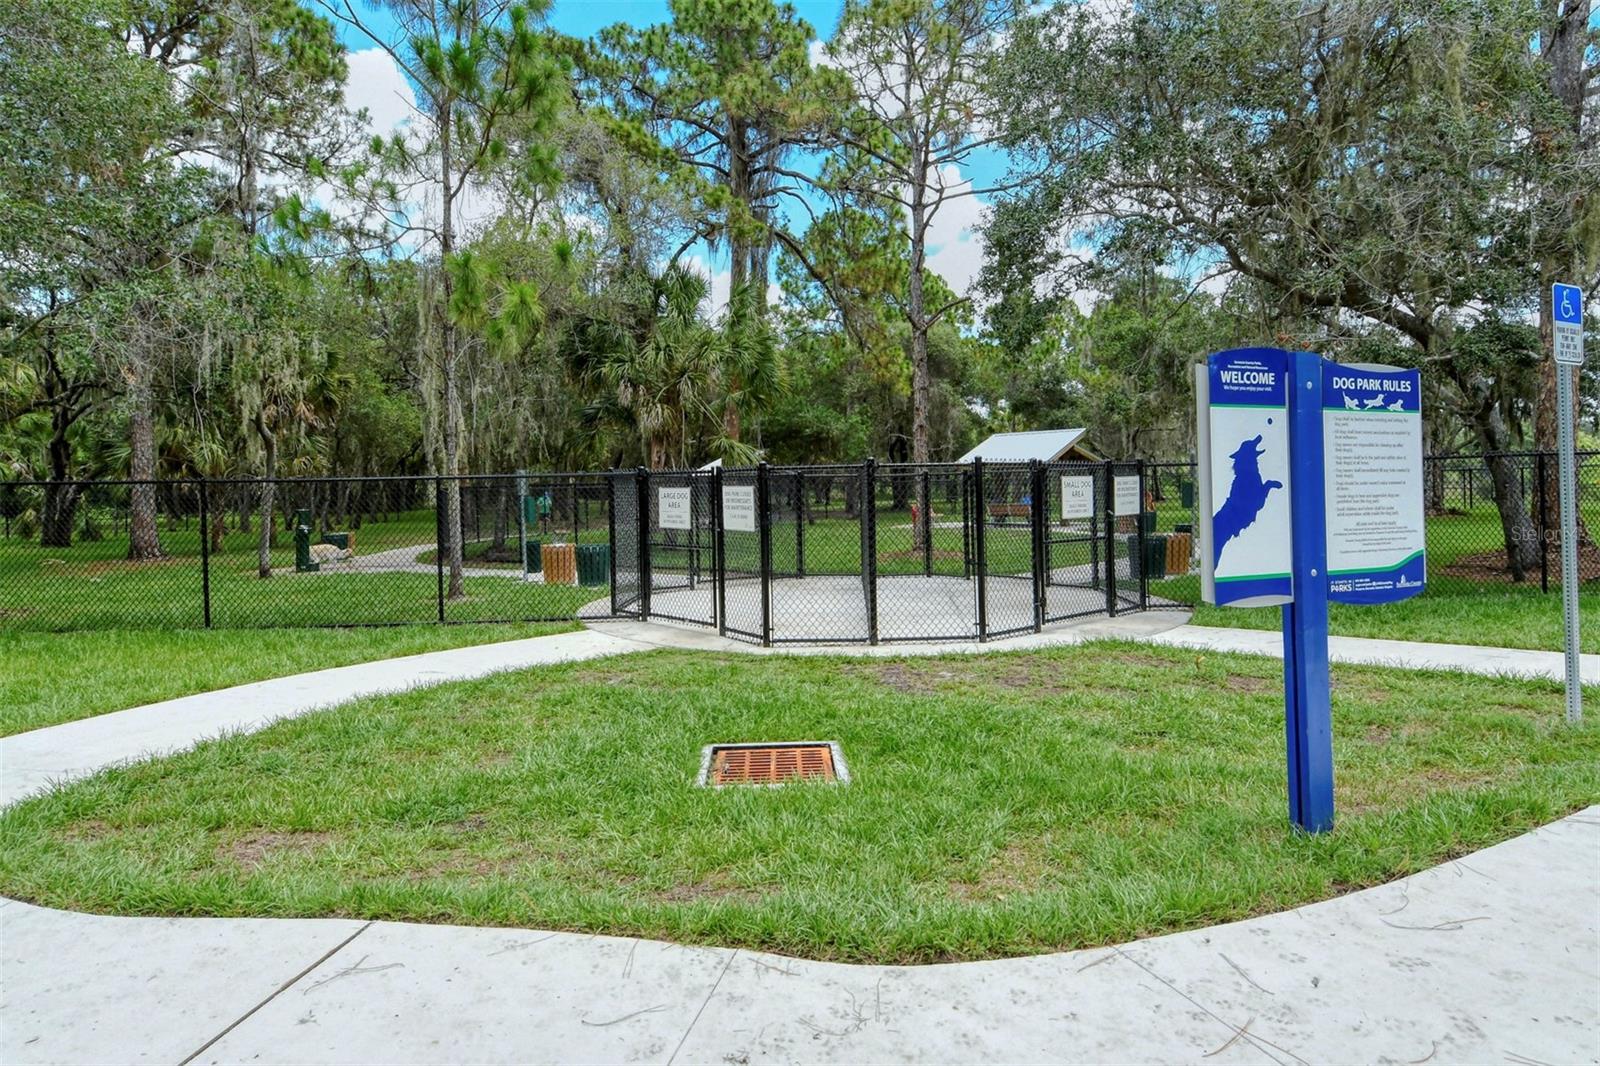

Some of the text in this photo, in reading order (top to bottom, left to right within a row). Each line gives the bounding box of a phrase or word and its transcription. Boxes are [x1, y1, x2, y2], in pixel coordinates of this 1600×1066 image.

[1220, 370, 1275, 385] WELCOME
[1333, 377, 1412, 392] DOG PARK RULES
[1330, 584, 1352, 593] PARKS
